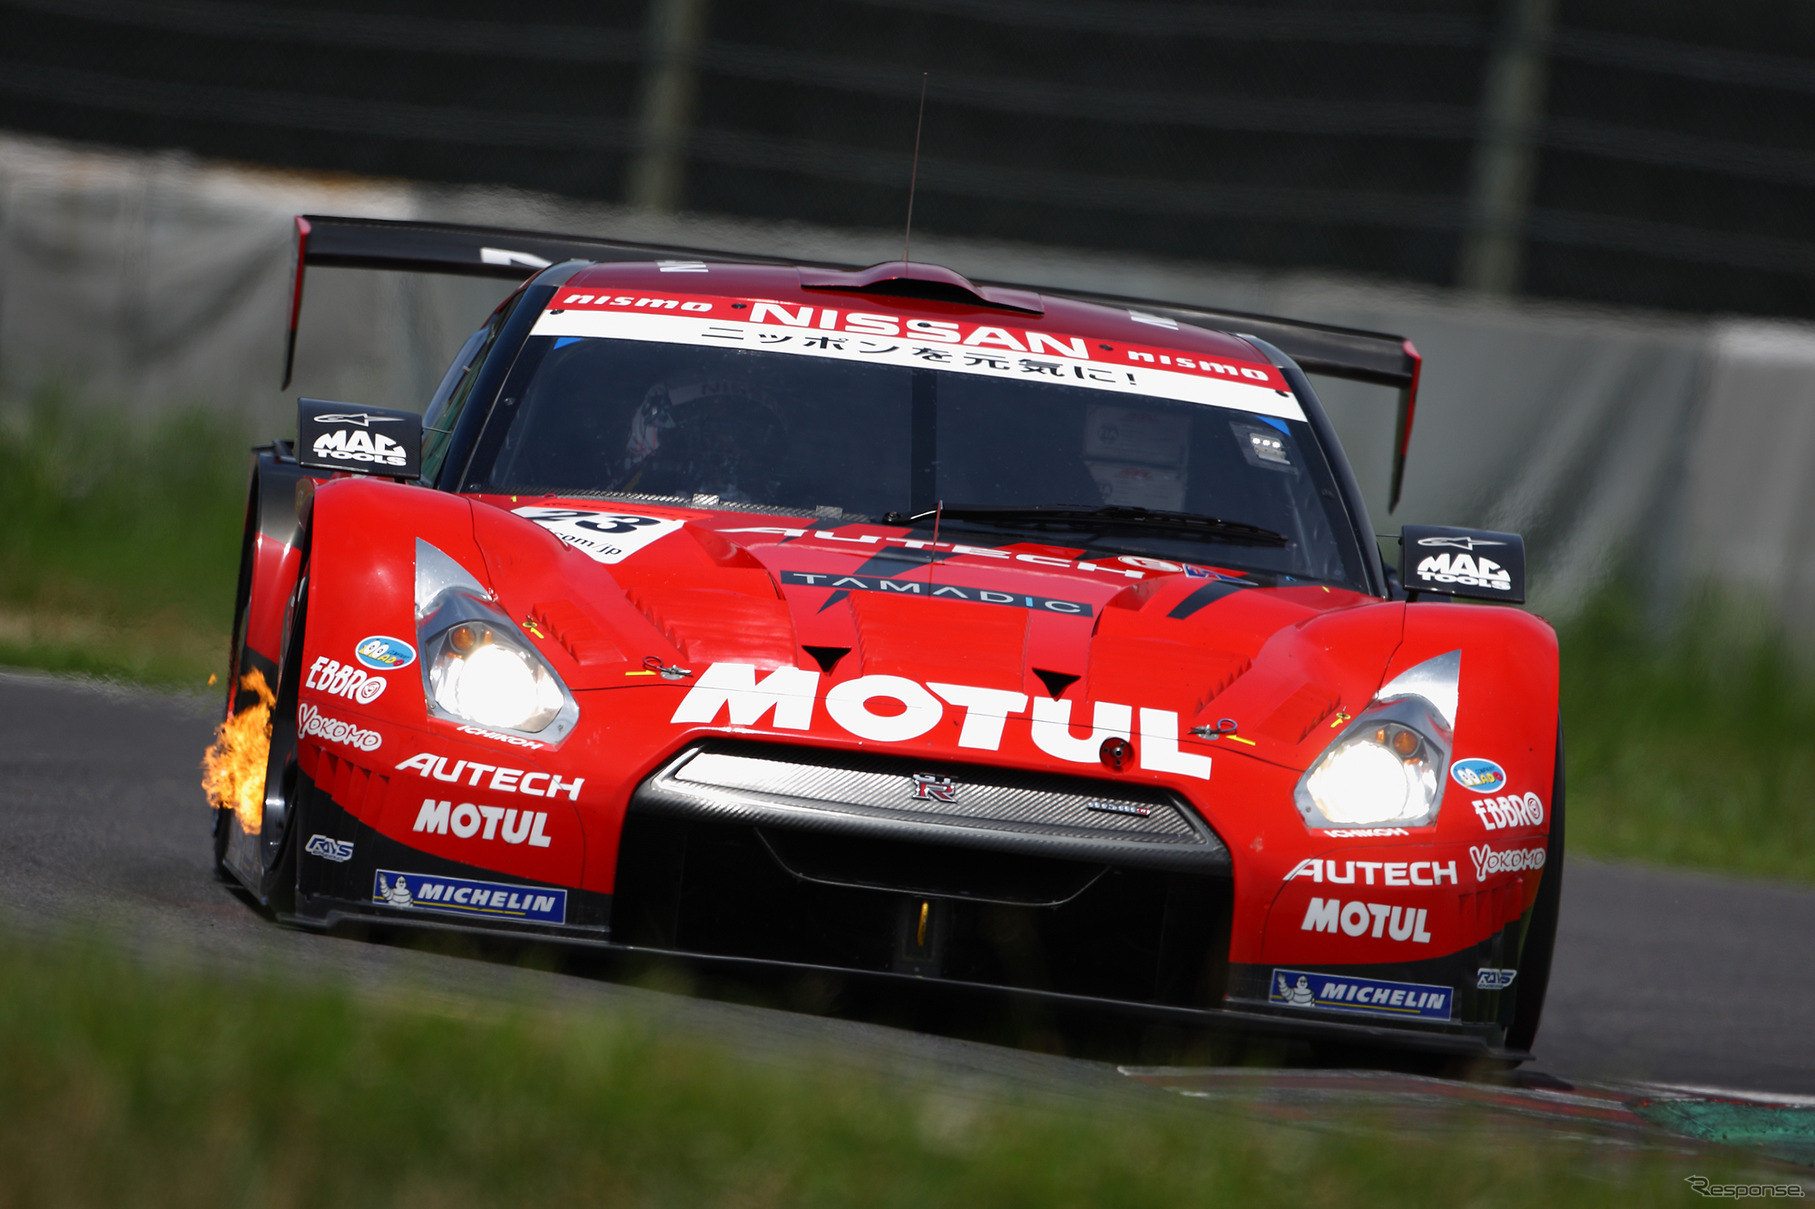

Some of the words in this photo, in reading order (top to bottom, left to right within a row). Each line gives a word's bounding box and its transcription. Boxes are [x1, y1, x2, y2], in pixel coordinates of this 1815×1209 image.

[563, 294, 713, 313] nismo
[749, 302, 1090, 360] NISSAN
[1127, 350, 1270, 382] nismo
[313, 429, 406, 458] MAC
[313, 448, 406, 467] TOOLS
[523, 510, 661, 534] 23
[714, 527, 1145, 579] AUTECH
[1417, 553, 1511, 582] MAC
[793, 573, 1081, 613] TAMADIC
[1417, 571, 1511, 591] TOOLS
[305, 656, 387, 705] EBBRO
[298, 703, 382, 751] YOKOMO
[670, 662, 1213, 780] MOTUL
[457, 725, 544, 750] ICHIKOH
[395, 753, 585, 801] AUTECH
[413, 799, 551, 847] MOTUL
[1471, 792, 1544, 831] EBBRO
[1324, 828, 1409, 838] ICHIKOH
[1283, 858, 1458, 886] AUTECH
[1469, 844, 1546, 882] YOKOMO
[417, 883, 555, 912] MICHELIN
[1301, 897, 1431, 943] MOTUL
[1320, 982, 1445, 1009] MICHELIN
